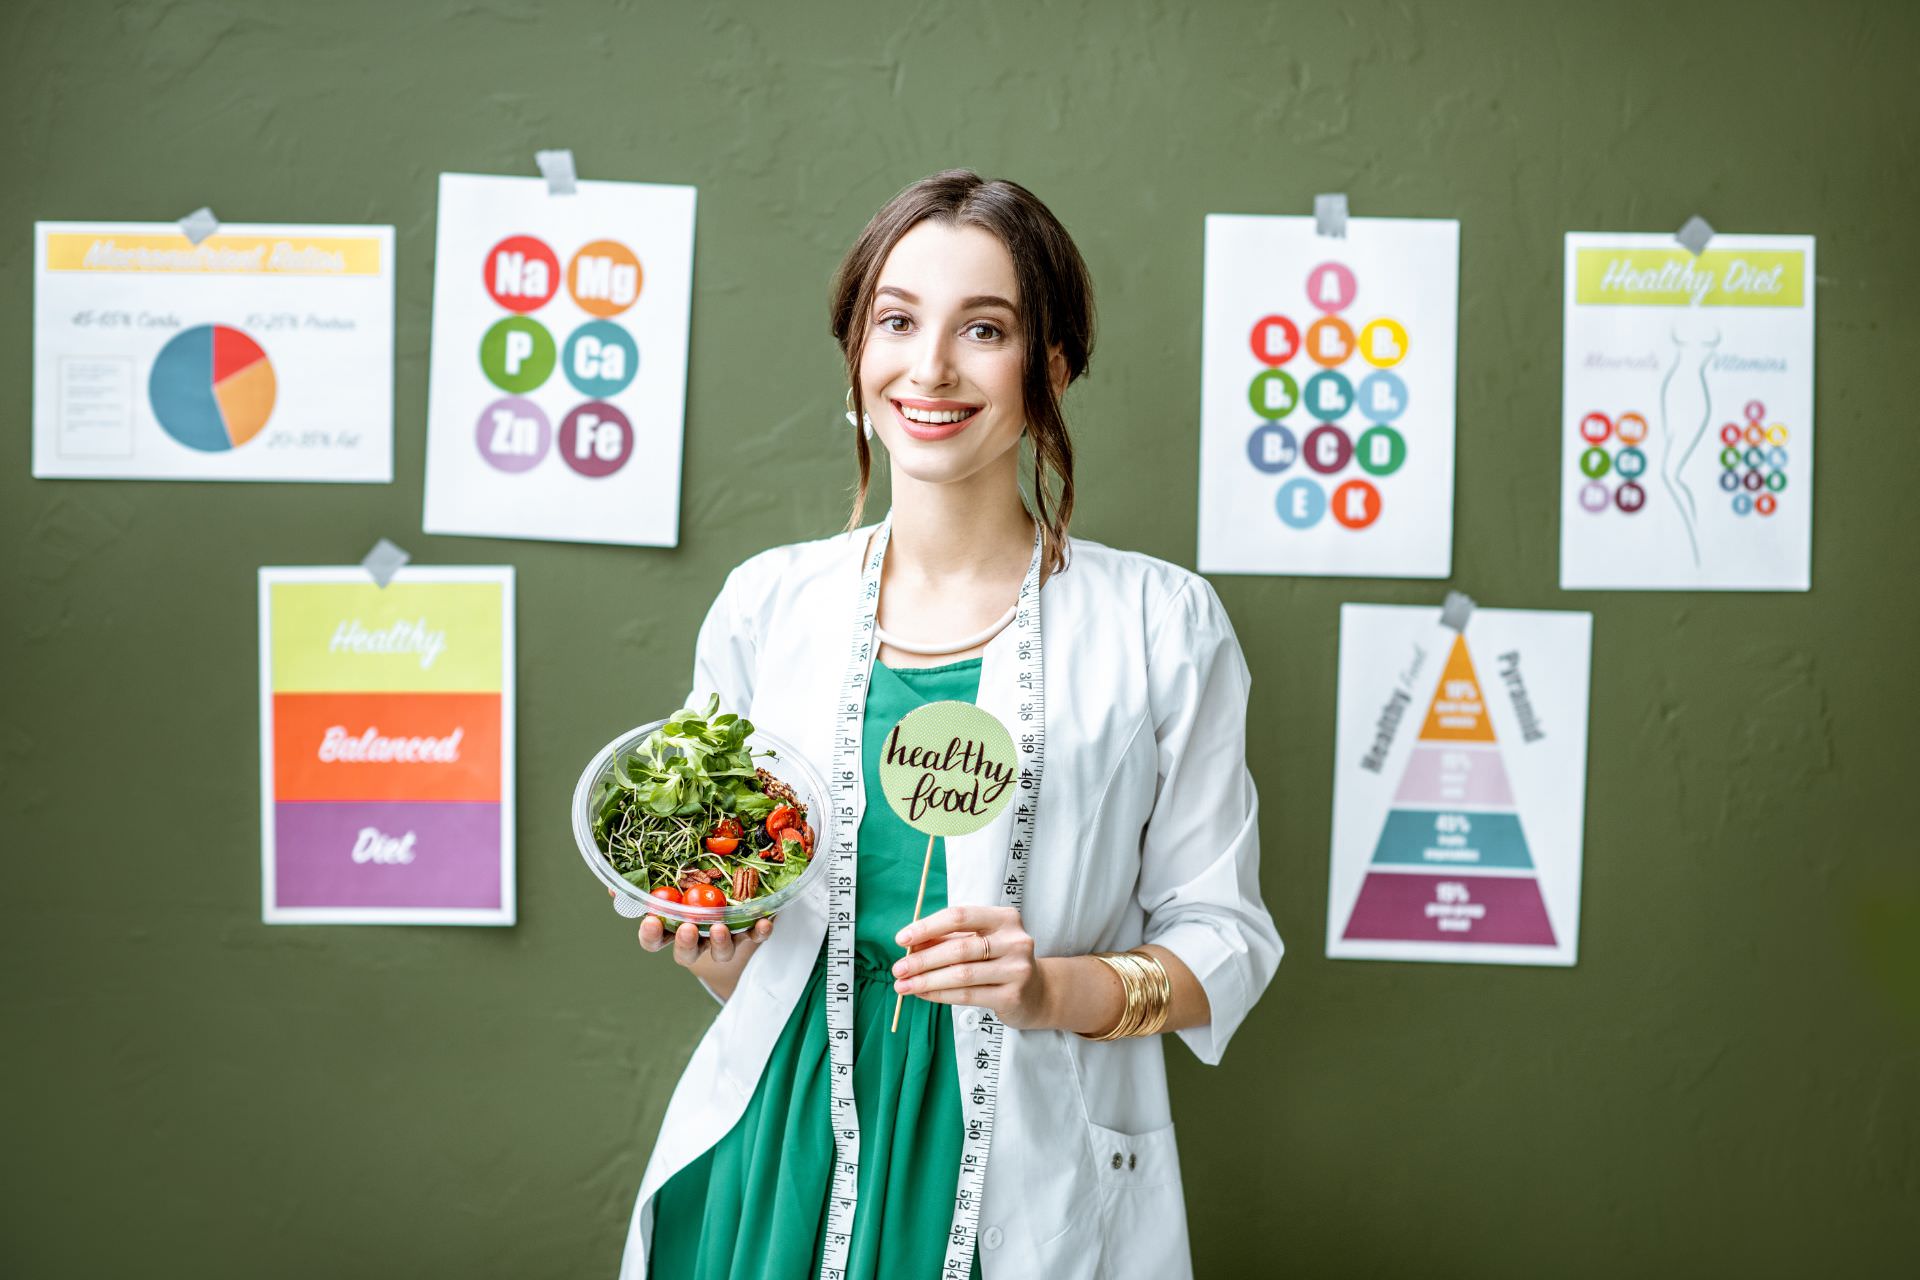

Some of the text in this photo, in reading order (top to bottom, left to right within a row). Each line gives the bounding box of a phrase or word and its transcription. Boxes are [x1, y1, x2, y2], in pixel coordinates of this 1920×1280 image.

[495, 251, 638, 307] Na Mg
[1319, 270, 1342, 304] A
[1600, 258, 1786, 308] Healthy Diet
[504, 330, 627, 382] P Ca
[489, 409, 623, 462] Zn Fe
[1315, 432, 1340, 466] C
[1370, 434, 1392, 467] D
[1292, 486, 1368, 521] E K
[866, 580, 878, 600] 22
[862, 612, 874, 632] 21
[1018, 609, 1030, 628] 35
[328, 618, 448, 671] Healthy
[858, 642, 869, 663] 20
[1019, 640, 1032, 661] 36
[851, 673, 864, 689] 19
[1019, 672, 1033, 690] 37
[846, 703, 859, 722] 18
[1020, 703, 1034, 721] 38
[318, 724, 464, 764] Balanced
[843, 736, 856, 756] 17
[1021, 734, 1035, 754] 39
[887, 725, 1018, 803] healthy
[842, 770, 854, 791] 16
[1020, 768, 1034, 790] 40
[901, 772, 988, 821] food
[841, 806, 854, 826] 15
[1017, 803, 1030, 825] 41
[351, 826, 418, 865] Diet
[840, 841, 853, 862] 14
[1012, 839, 1024, 860] 42
[838, 876, 851, 896] 13
[1005, 874, 1018, 895] 43
[837, 911, 850, 931] 12
[837, 947, 850, 967] 11
[836, 982, 849, 1003] 10
[980, 1012, 994, 1035] 47
[835, 1030, 848, 1040] 9
[976, 1048, 990, 1070] 48
[837, 1065, 848, 1076] 8
[838, 1100, 851, 1108] 7
[972, 1083, 986, 1105] 49
[843, 1130, 856, 1140] 6
[968, 1119, 982, 1141] 50
[844, 1164, 855, 1175] 5
[963, 1153, 978, 1175] 51
[840, 1200, 852, 1210] 4
[958, 1189, 973, 1211] 52
[834, 1234, 846, 1245] 3
[952, 1224, 967, 1246] 53
[945, 1258, 961, 1280] 54
